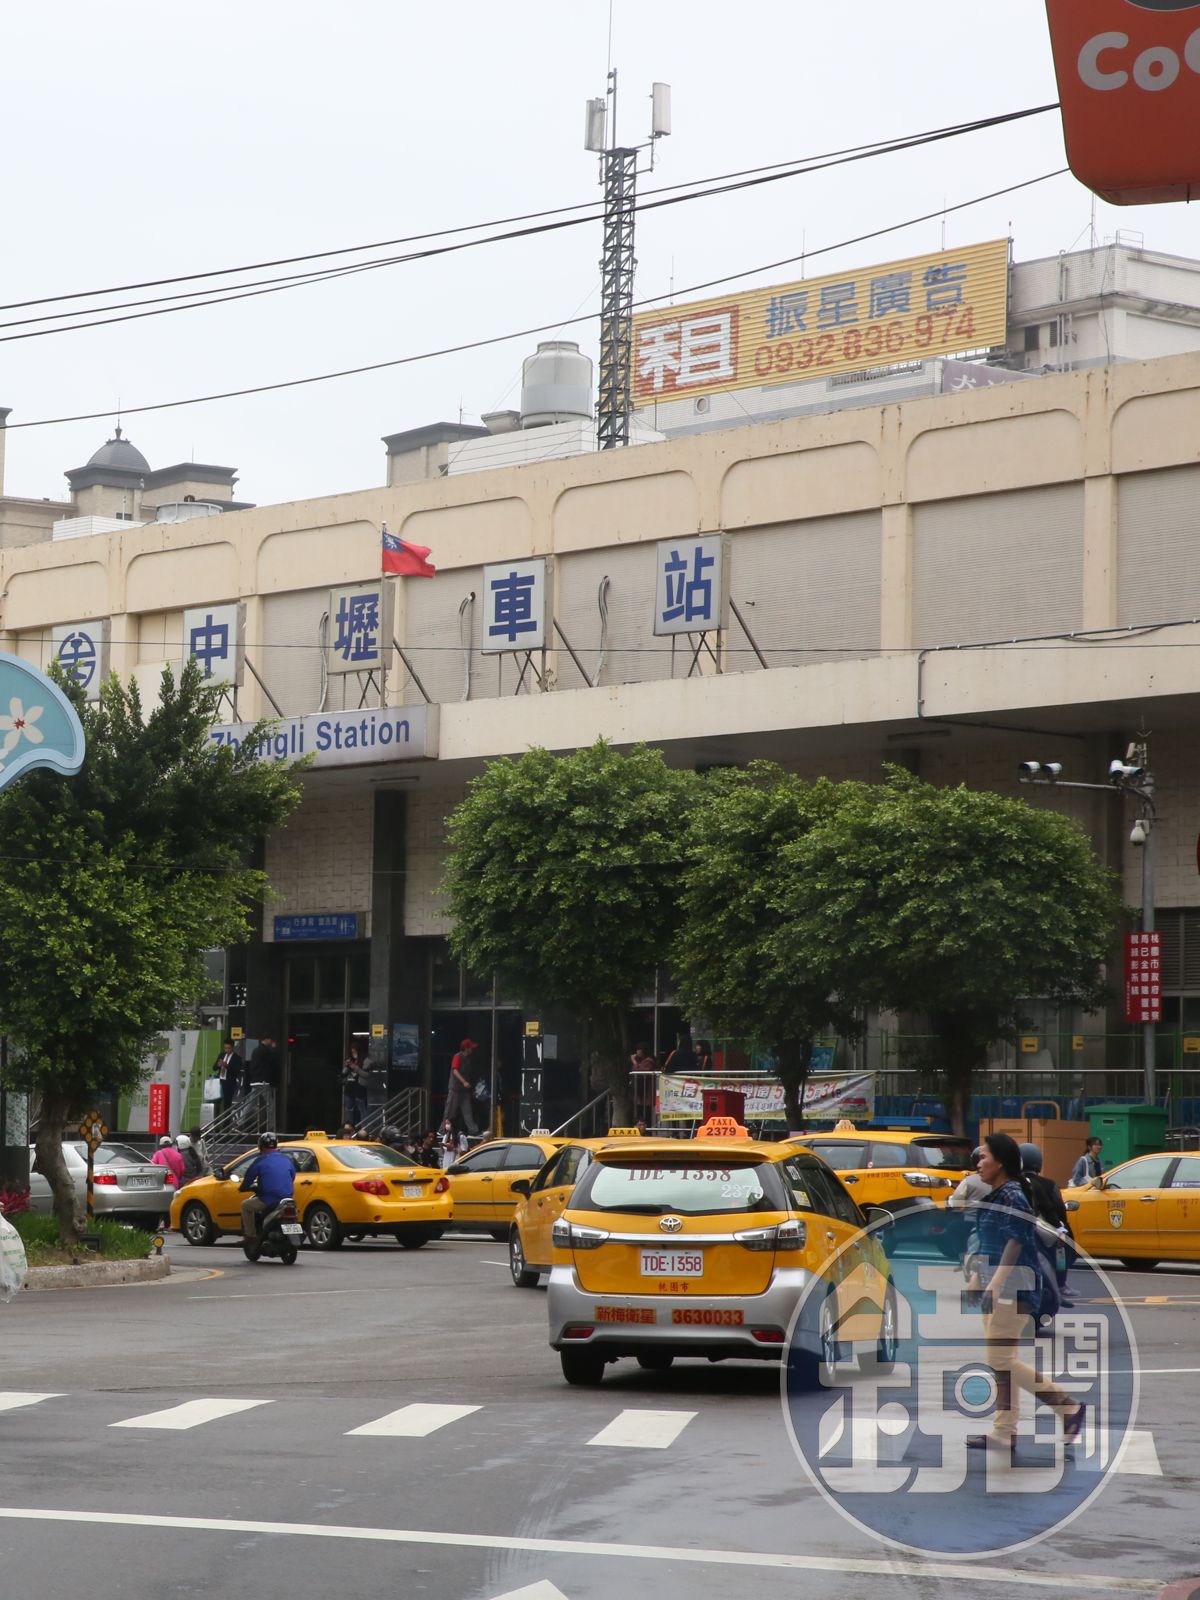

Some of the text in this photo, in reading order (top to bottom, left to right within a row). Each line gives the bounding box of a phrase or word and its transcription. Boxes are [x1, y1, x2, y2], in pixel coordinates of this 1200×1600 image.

[765, 263, 968, 339] 振星廣告
[639, 312, 735, 391] 租
[190, 546, 716, 679] 中壢車站
[316, 716, 410, 751] Station
[706, 1127, 737, 1136] 2379
[711, 1118, 733, 1126] TAXI
[658, 1281, 689, 1292] 桃園市
[672, 1308, 744, 1325] 3630033
